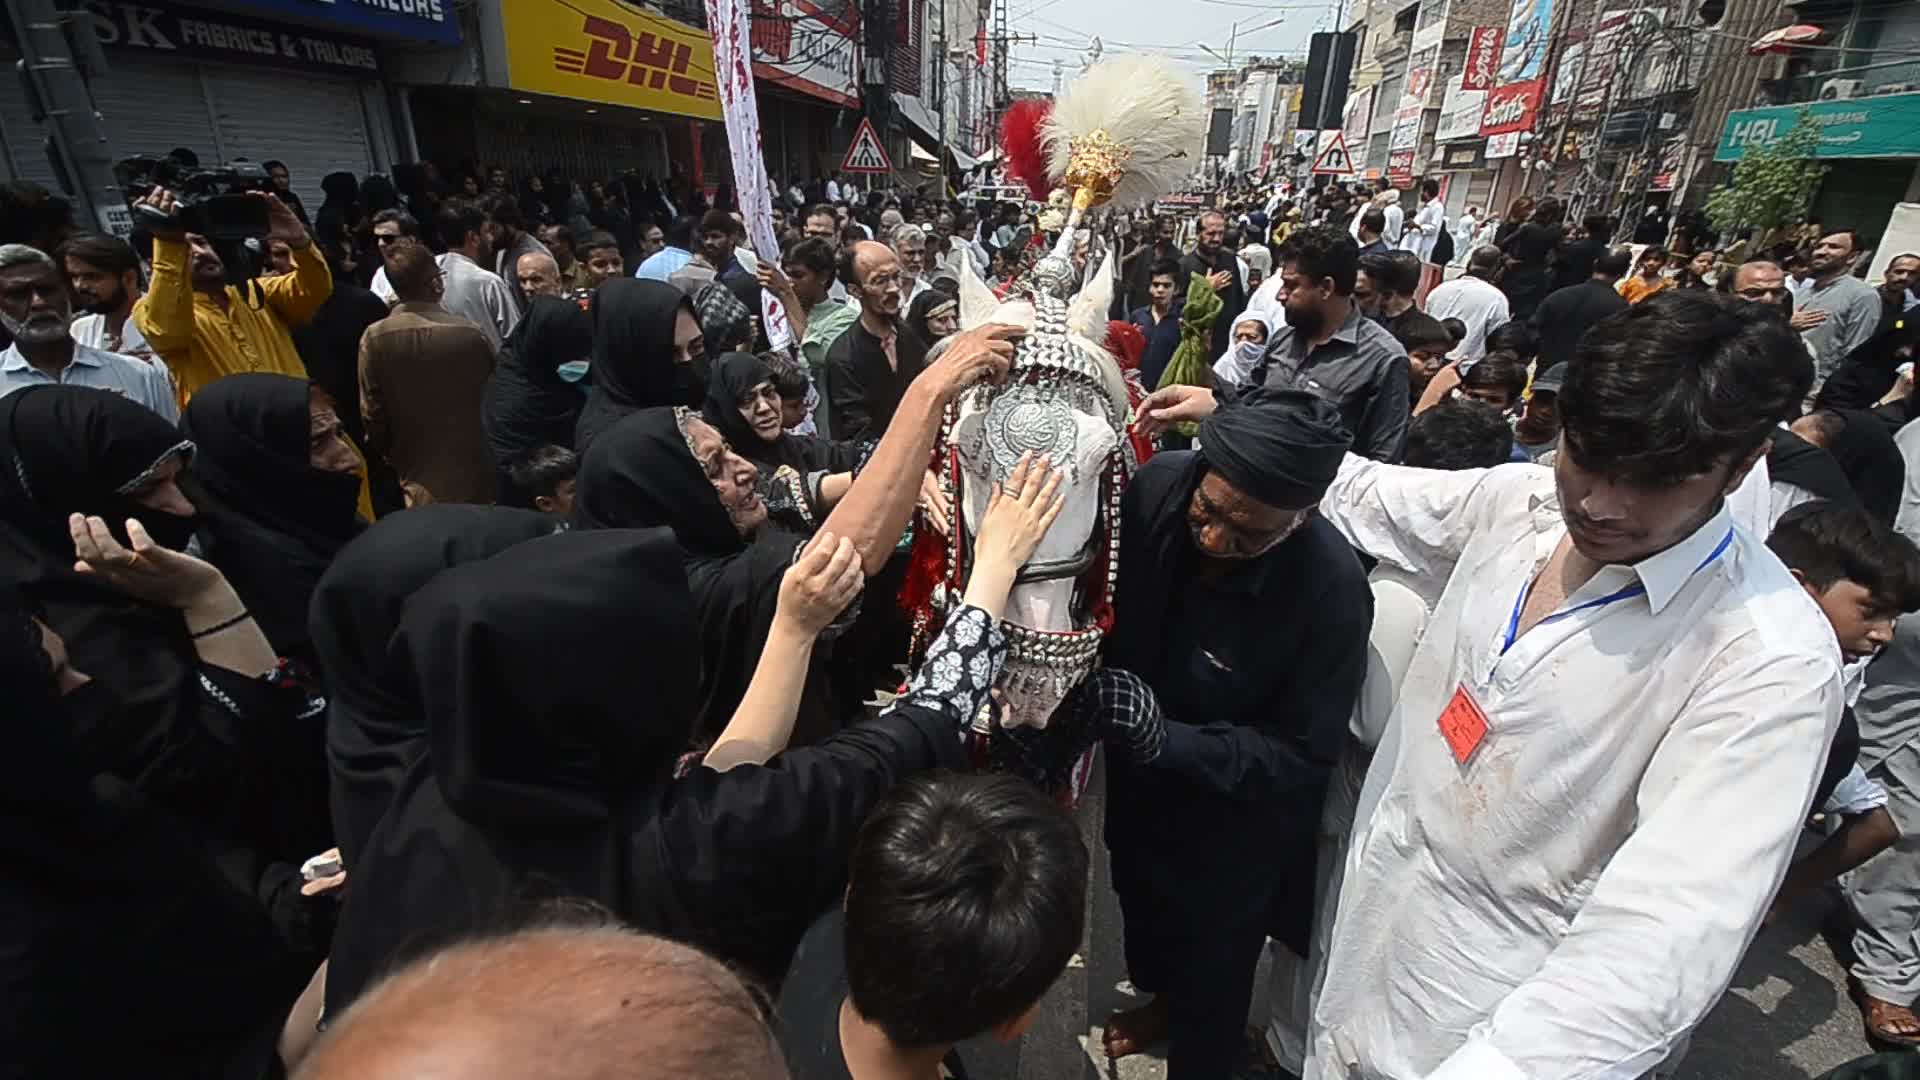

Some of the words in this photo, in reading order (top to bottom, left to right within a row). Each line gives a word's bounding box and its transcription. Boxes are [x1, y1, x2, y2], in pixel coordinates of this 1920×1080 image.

[178, 17, 276, 56] FABRICS
[279, 33, 298, 57] &
[299, 37, 378, 70] TAILORS
[582, 15, 699, 96] DHL
[1728, 119, 1783, 147] HBL
